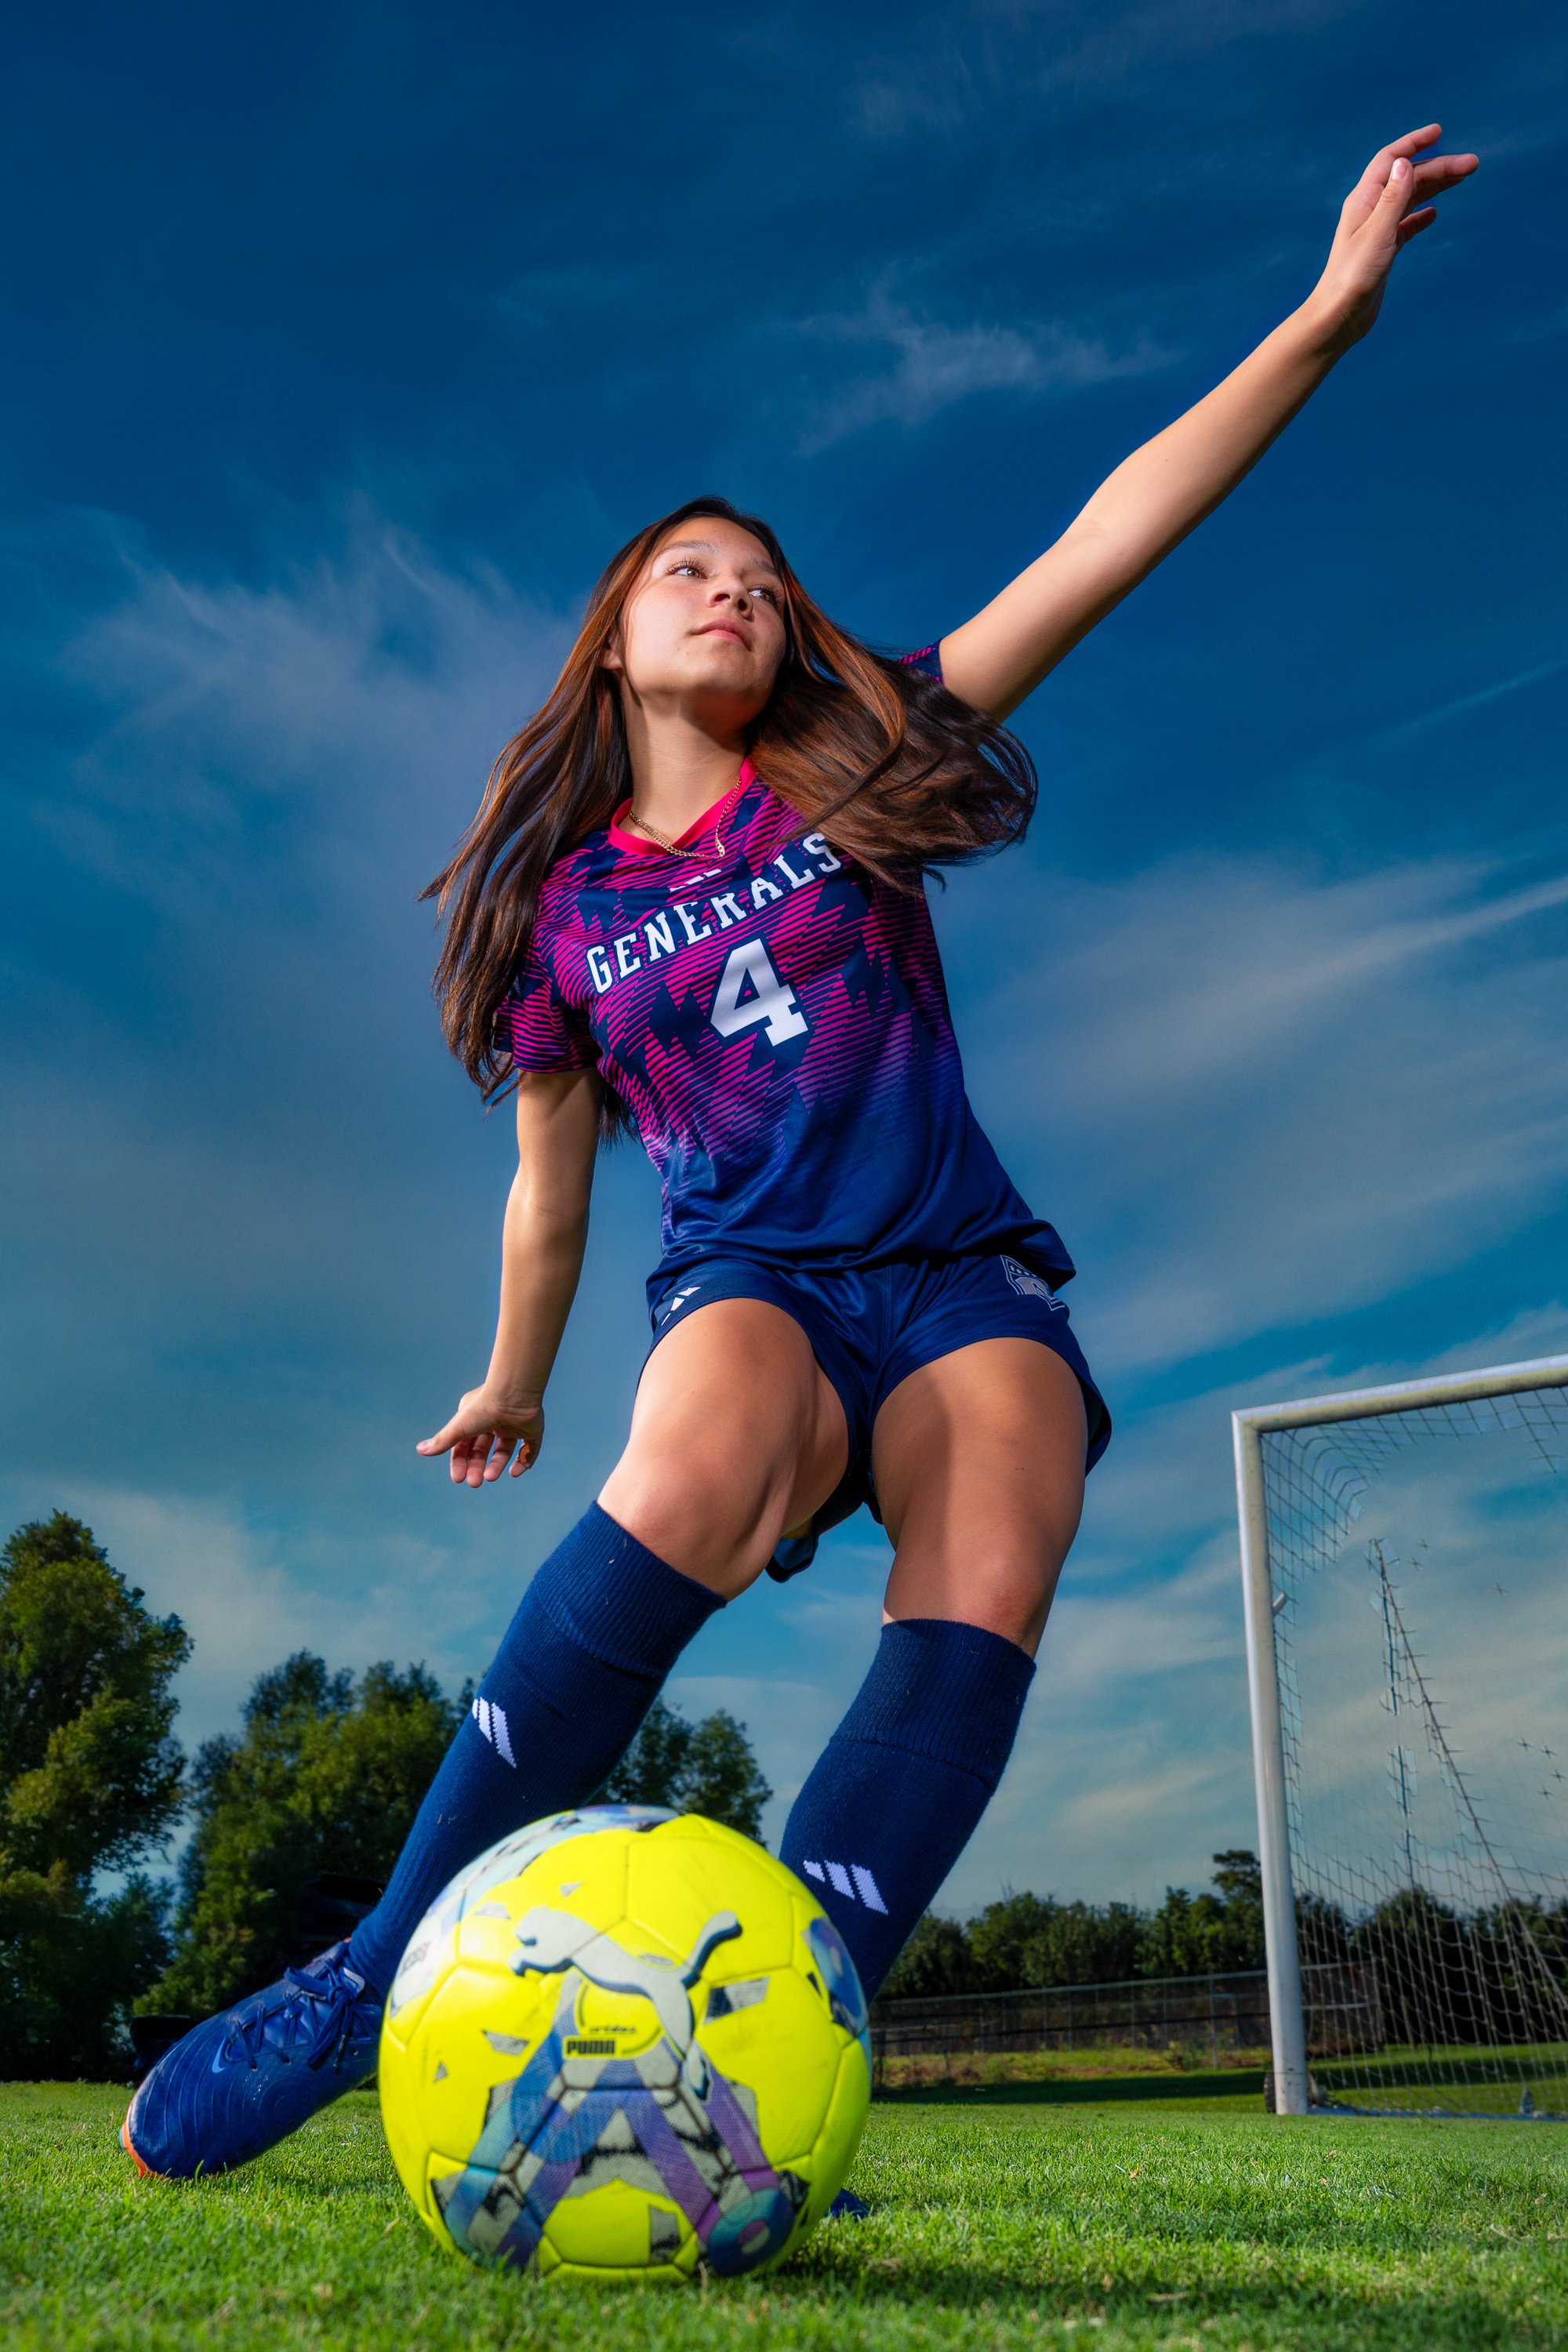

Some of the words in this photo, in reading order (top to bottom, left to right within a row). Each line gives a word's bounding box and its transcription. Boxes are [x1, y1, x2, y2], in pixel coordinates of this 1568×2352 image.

[586, 833, 841, 993] GENERALS
[710, 938, 808, 1047] 4
[567, 2040, 615, 2055] PUMA
